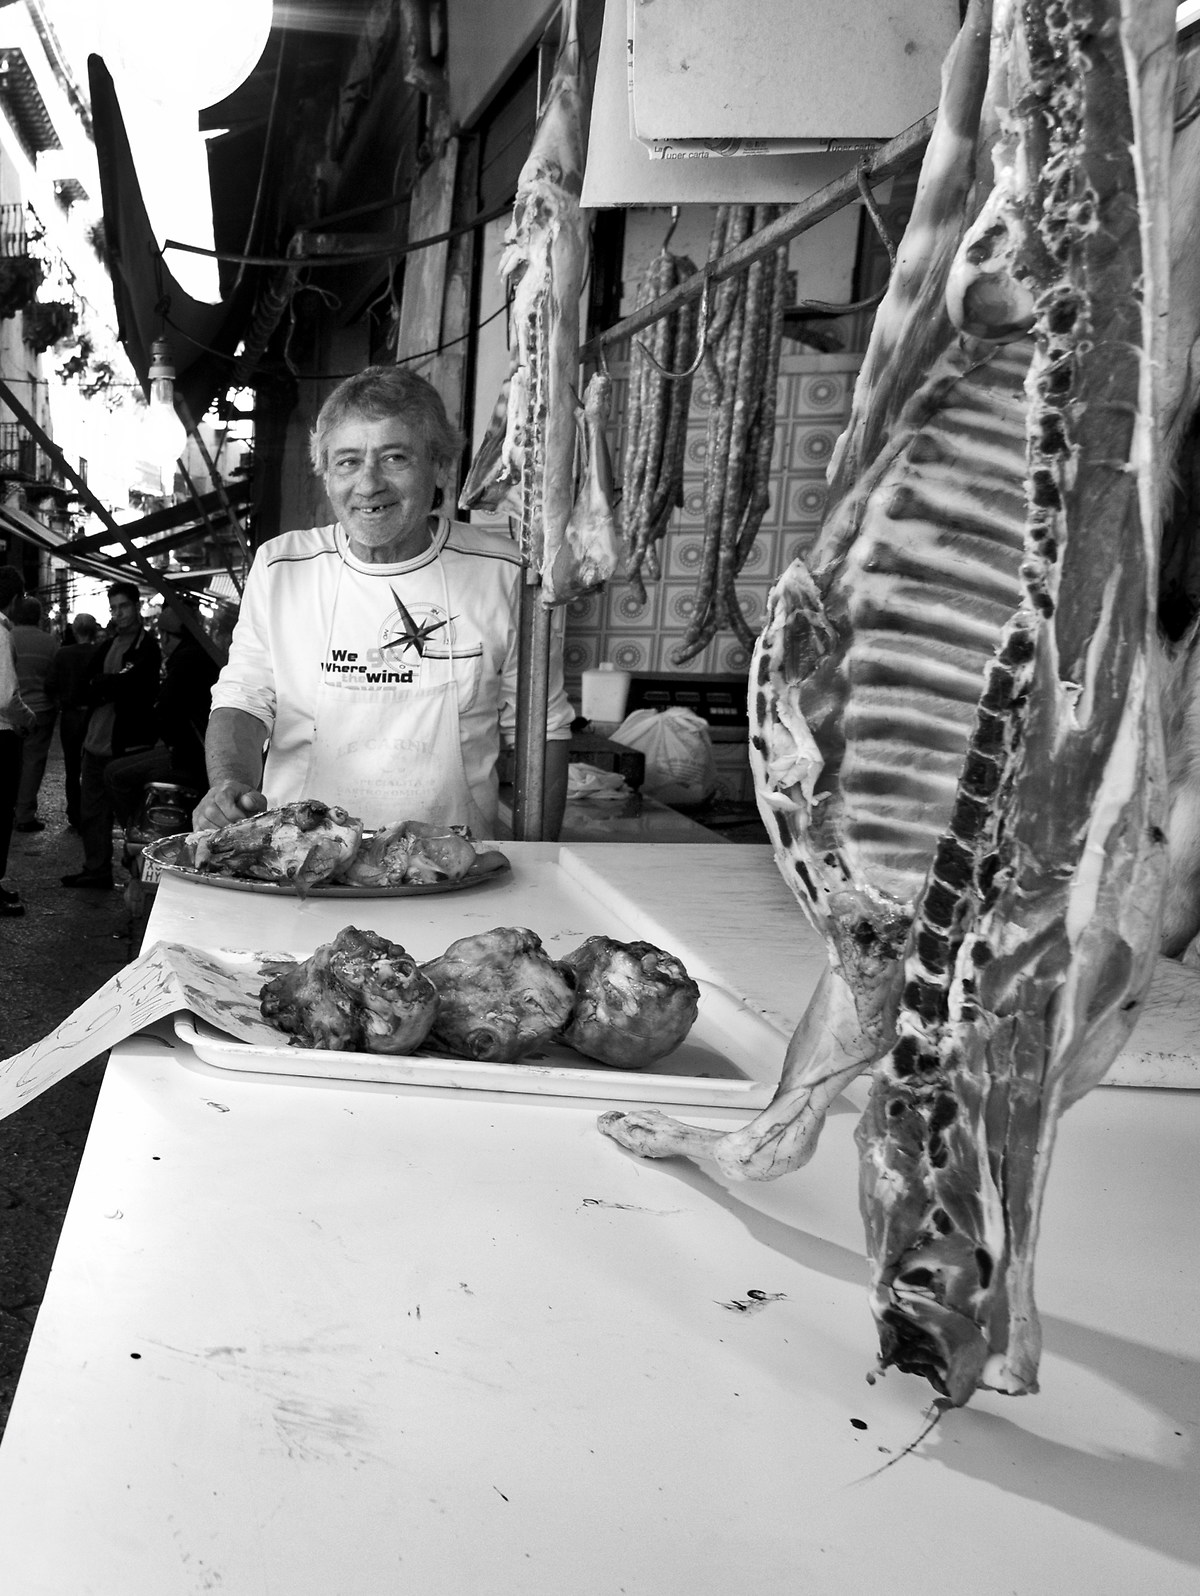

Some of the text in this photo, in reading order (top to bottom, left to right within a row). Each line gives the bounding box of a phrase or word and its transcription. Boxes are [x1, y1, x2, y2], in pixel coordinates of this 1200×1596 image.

[688, 150, 710, 159] carta
[332, 650, 358, 661] We
[321, 662, 367, 673] Where
[366, 670, 413, 683] wind
